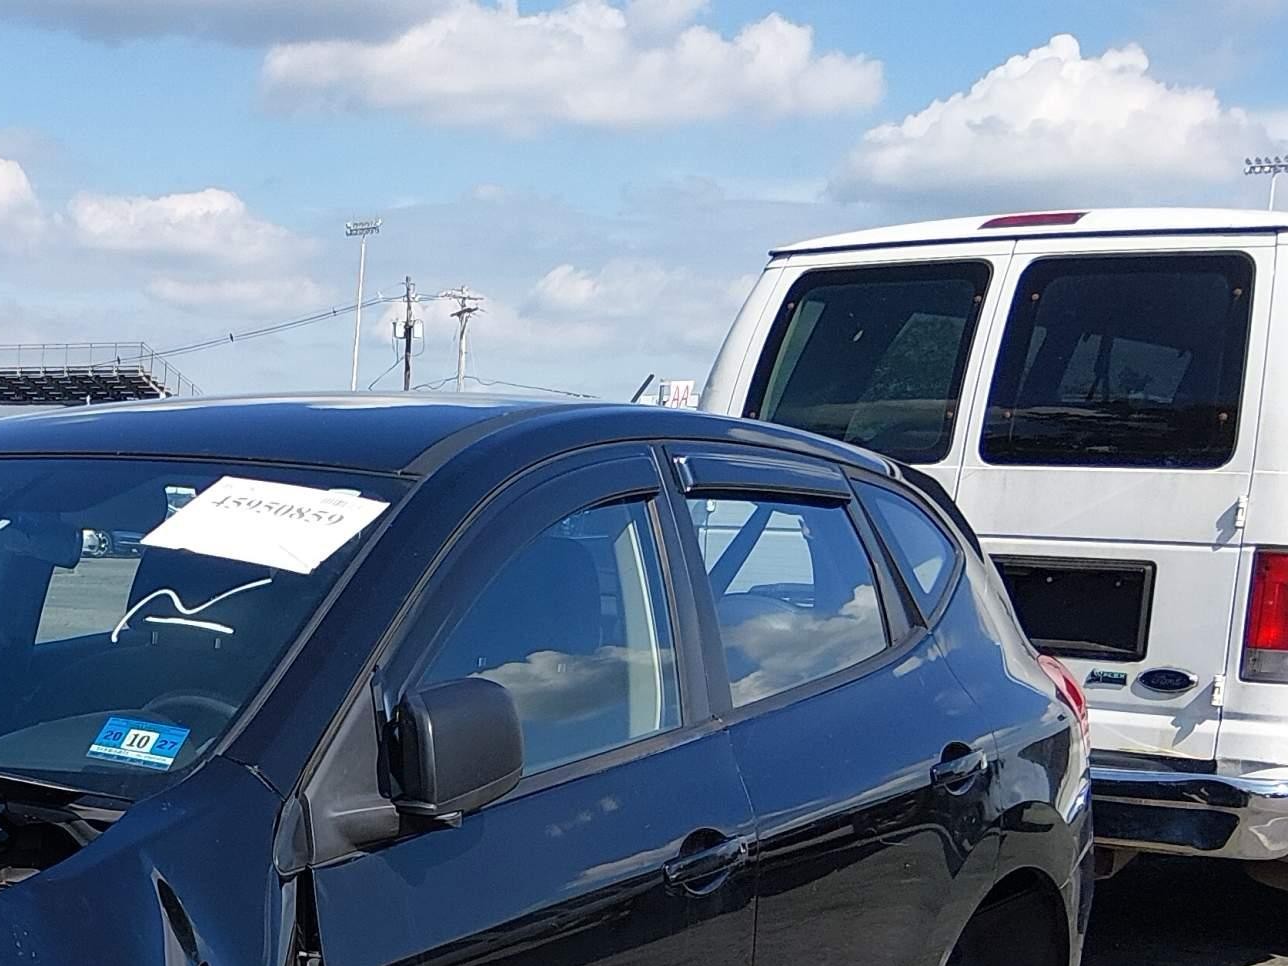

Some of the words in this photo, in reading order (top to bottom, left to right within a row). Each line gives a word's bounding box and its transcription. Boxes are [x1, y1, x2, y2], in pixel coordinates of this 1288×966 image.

[211, 495, 345, 526] 45950859
[103, 730, 124, 742] 20
[126, 733, 151, 749] 10
[156, 739, 178, 751] 27
